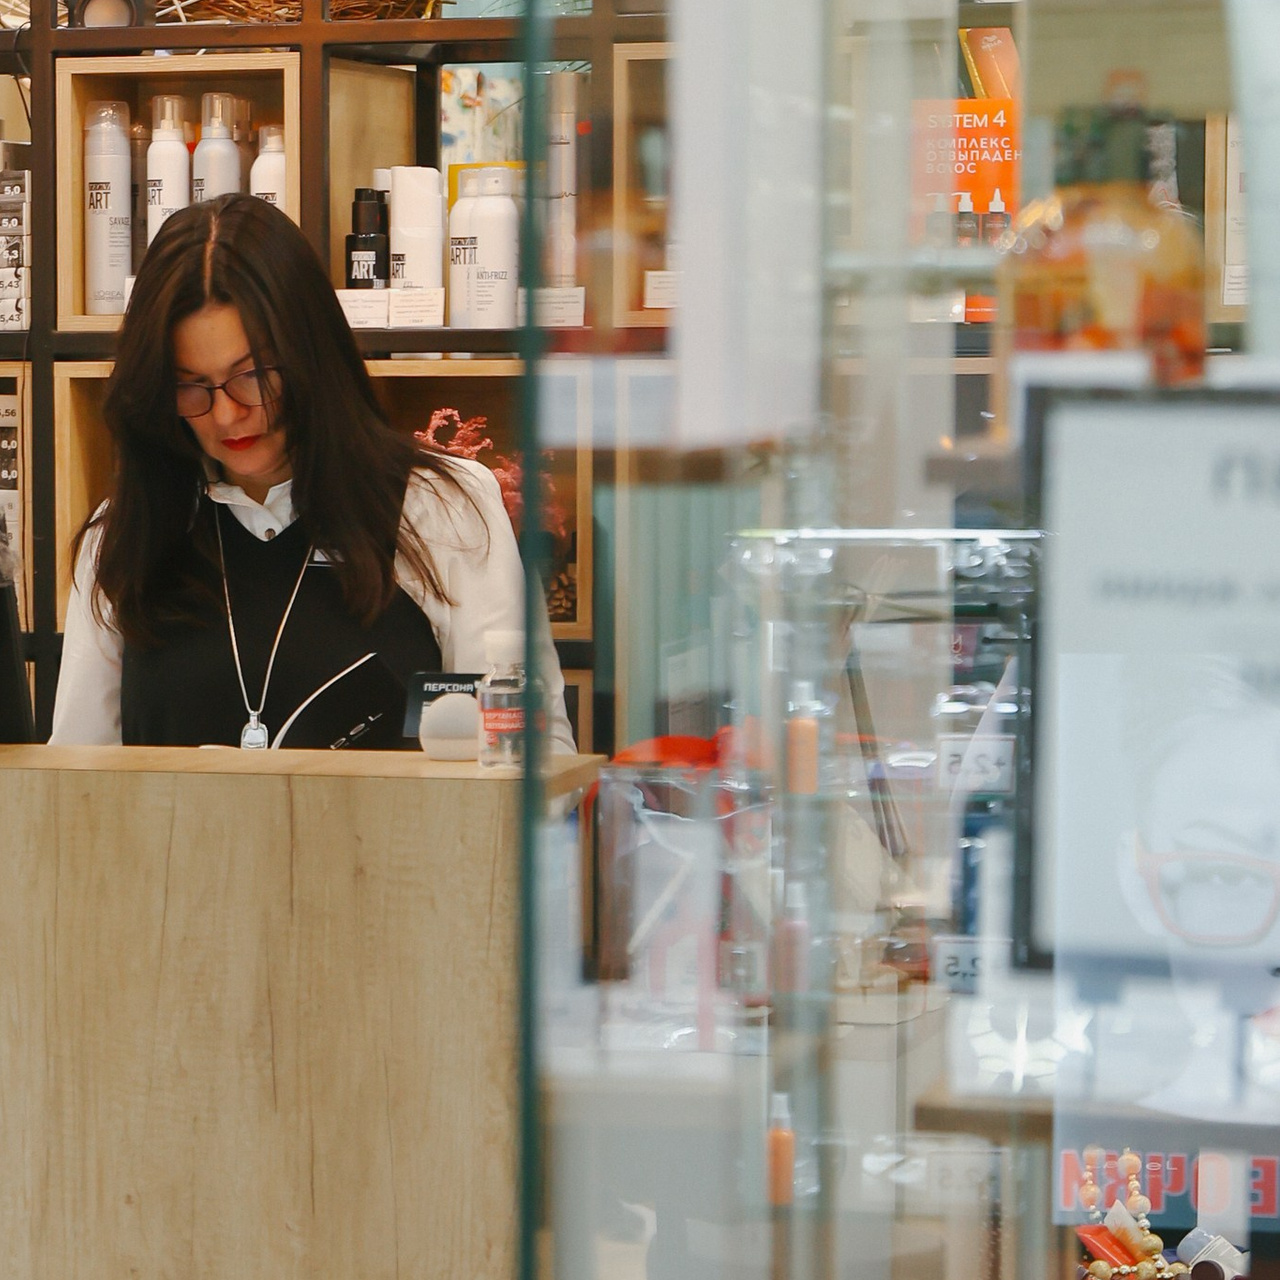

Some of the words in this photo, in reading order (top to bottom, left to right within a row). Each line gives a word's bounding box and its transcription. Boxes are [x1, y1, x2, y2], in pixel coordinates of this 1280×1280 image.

[992, 109, 1007, 128] 4
[4, 186, 20, 195] 5,0
[2, 218, 18, 228] 5,0
[476, 271, 508, 280] ANTI-FRIZZ
[0, 280, 19, 289] 5,43
[0, 314, 20, 323] 5,43
[423, 682, 474, 693] ПЕРСОНА
